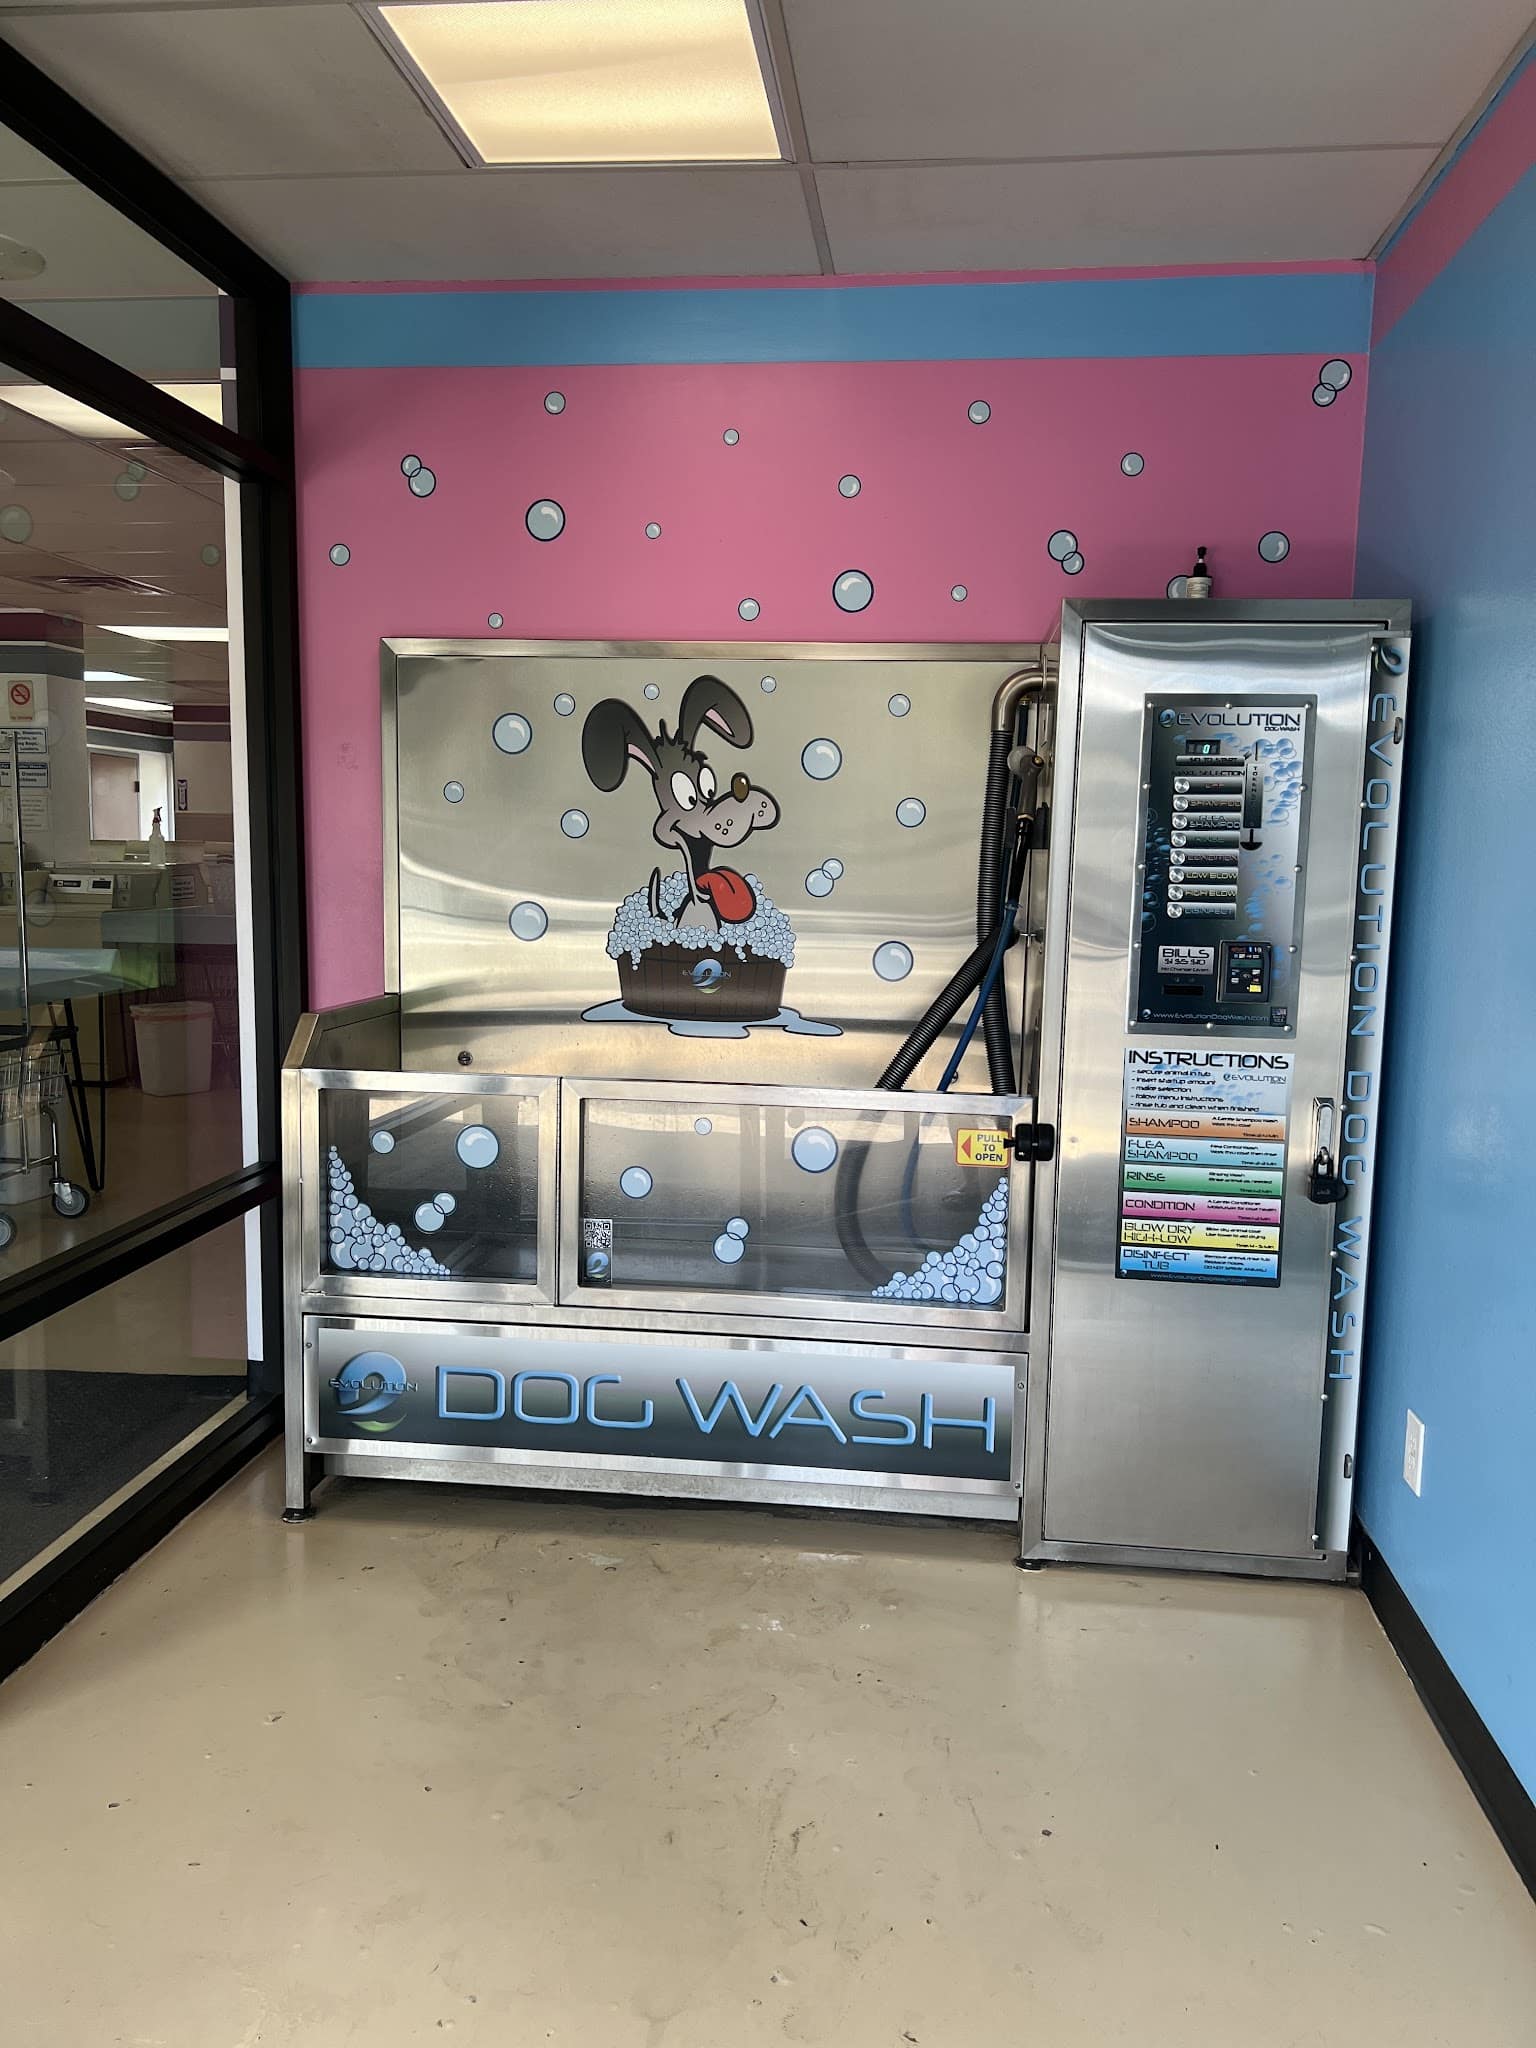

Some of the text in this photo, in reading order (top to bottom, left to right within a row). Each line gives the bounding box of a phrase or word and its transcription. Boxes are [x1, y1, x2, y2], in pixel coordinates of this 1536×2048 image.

[1176, 713, 1300, 726] EVOLUTION
[1202, 744, 1211, 754] 0
[1162, 948, 1210, 959] BILLS
[1329, 693, 1397, 1380] EVOLUTION DOG WASH
[1128, 1050, 1290, 1069] INSTRUCTIONS
[1231, 1074, 1287, 1082] EVOLUTION
[1129, 1117, 1200, 1129] SHAMPOO
[977, 1134, 1003, 1143] PULL
[1128, 1139, 1165, 1149] FLEA
[982, 1143, 996, 1152] TO
[975, 1153, 1003, 1162] OPEN
[1128, 1150, 1198, 1161] SHAMPOO
[1126, 1171, 1166, 1181] RINSE
[1125, 1199, 1196, 1211] CONDITION
[1124, 1222, 1196, 1235] BLOW DRY
[1124, 1232, 1191, 1244] HIGH-LOW
[1123, 1248, 1191, 1261] DISINFECT
[1142, 1260, 1170, 1270] TUB
[329, 1378, 418, 1392] EVOLUTION
[436, 1365, 995, 1454] DOG WASH
